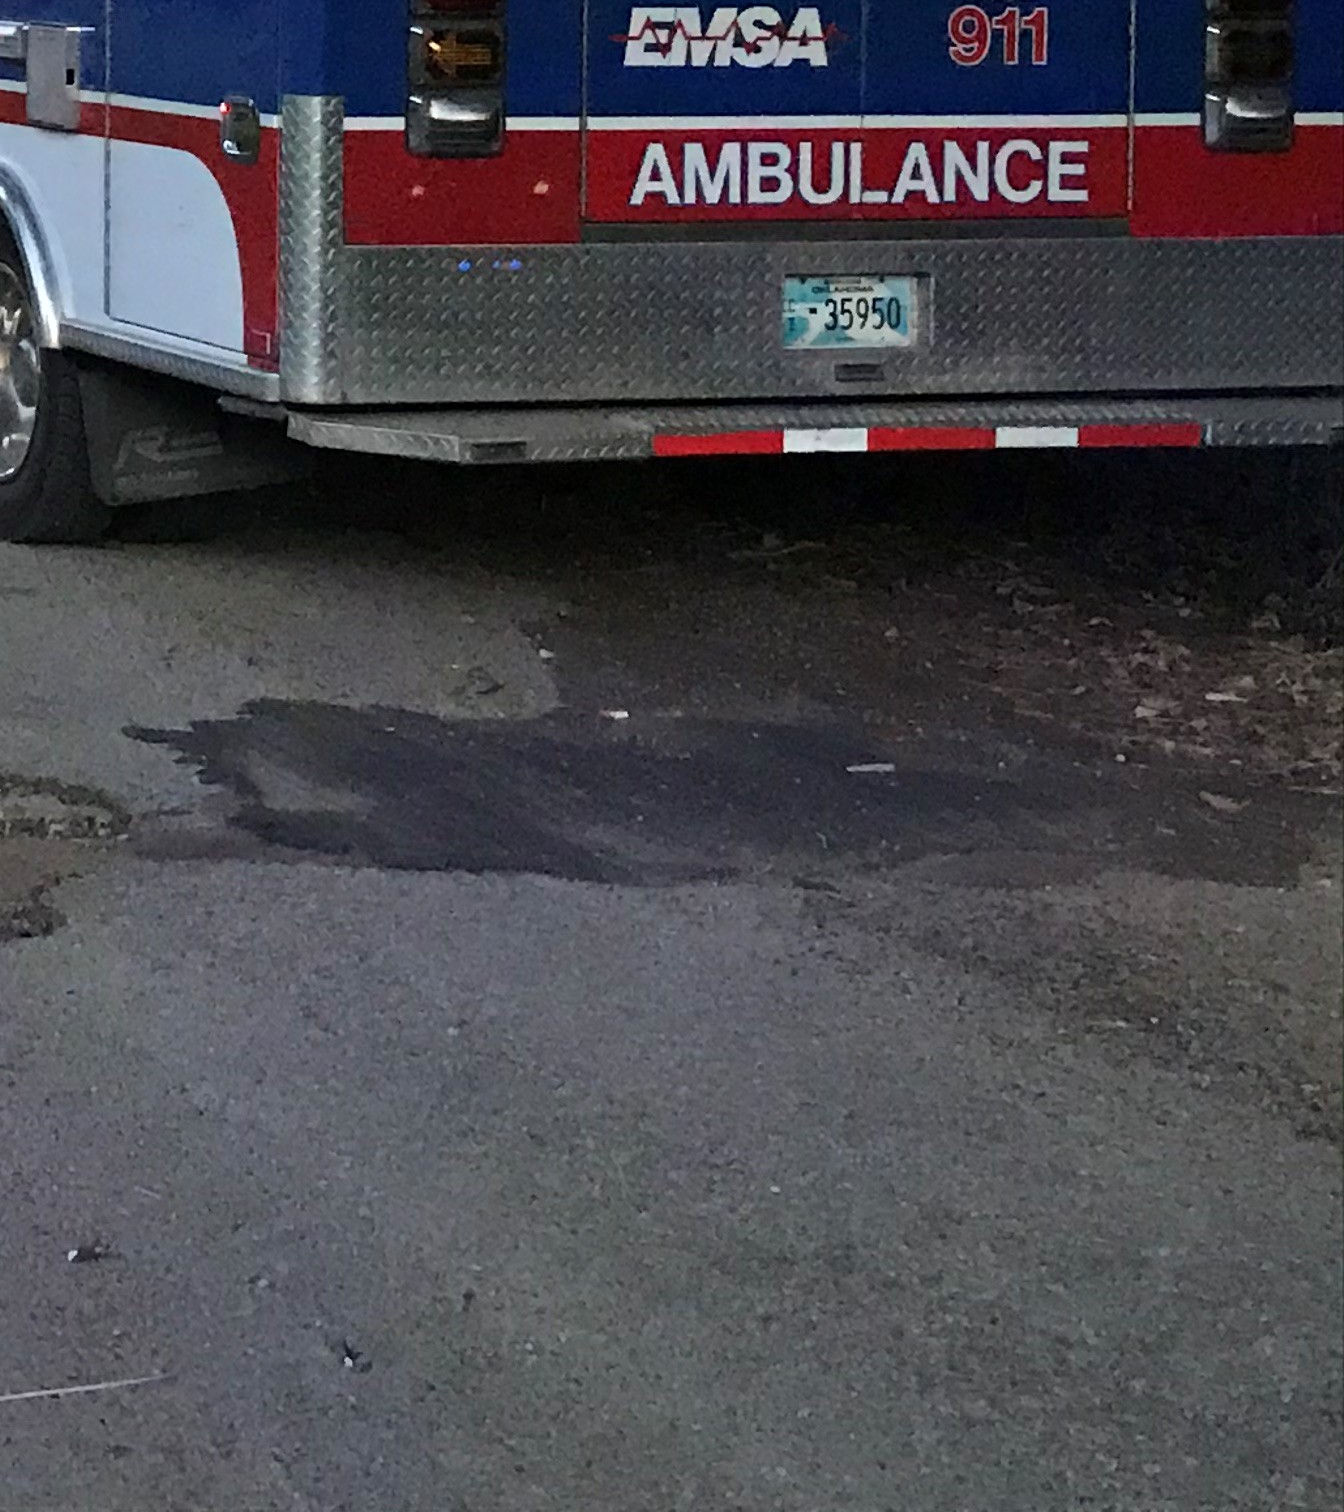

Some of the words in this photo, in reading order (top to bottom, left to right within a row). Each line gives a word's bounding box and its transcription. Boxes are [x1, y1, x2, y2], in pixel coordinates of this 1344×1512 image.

[624, 6, 828, 68] EMSA
[948, 5, 1049, 66] 911
[628, 139, 1090, 206] AMBULANCE
[824, 296, 901, 331] 35950
